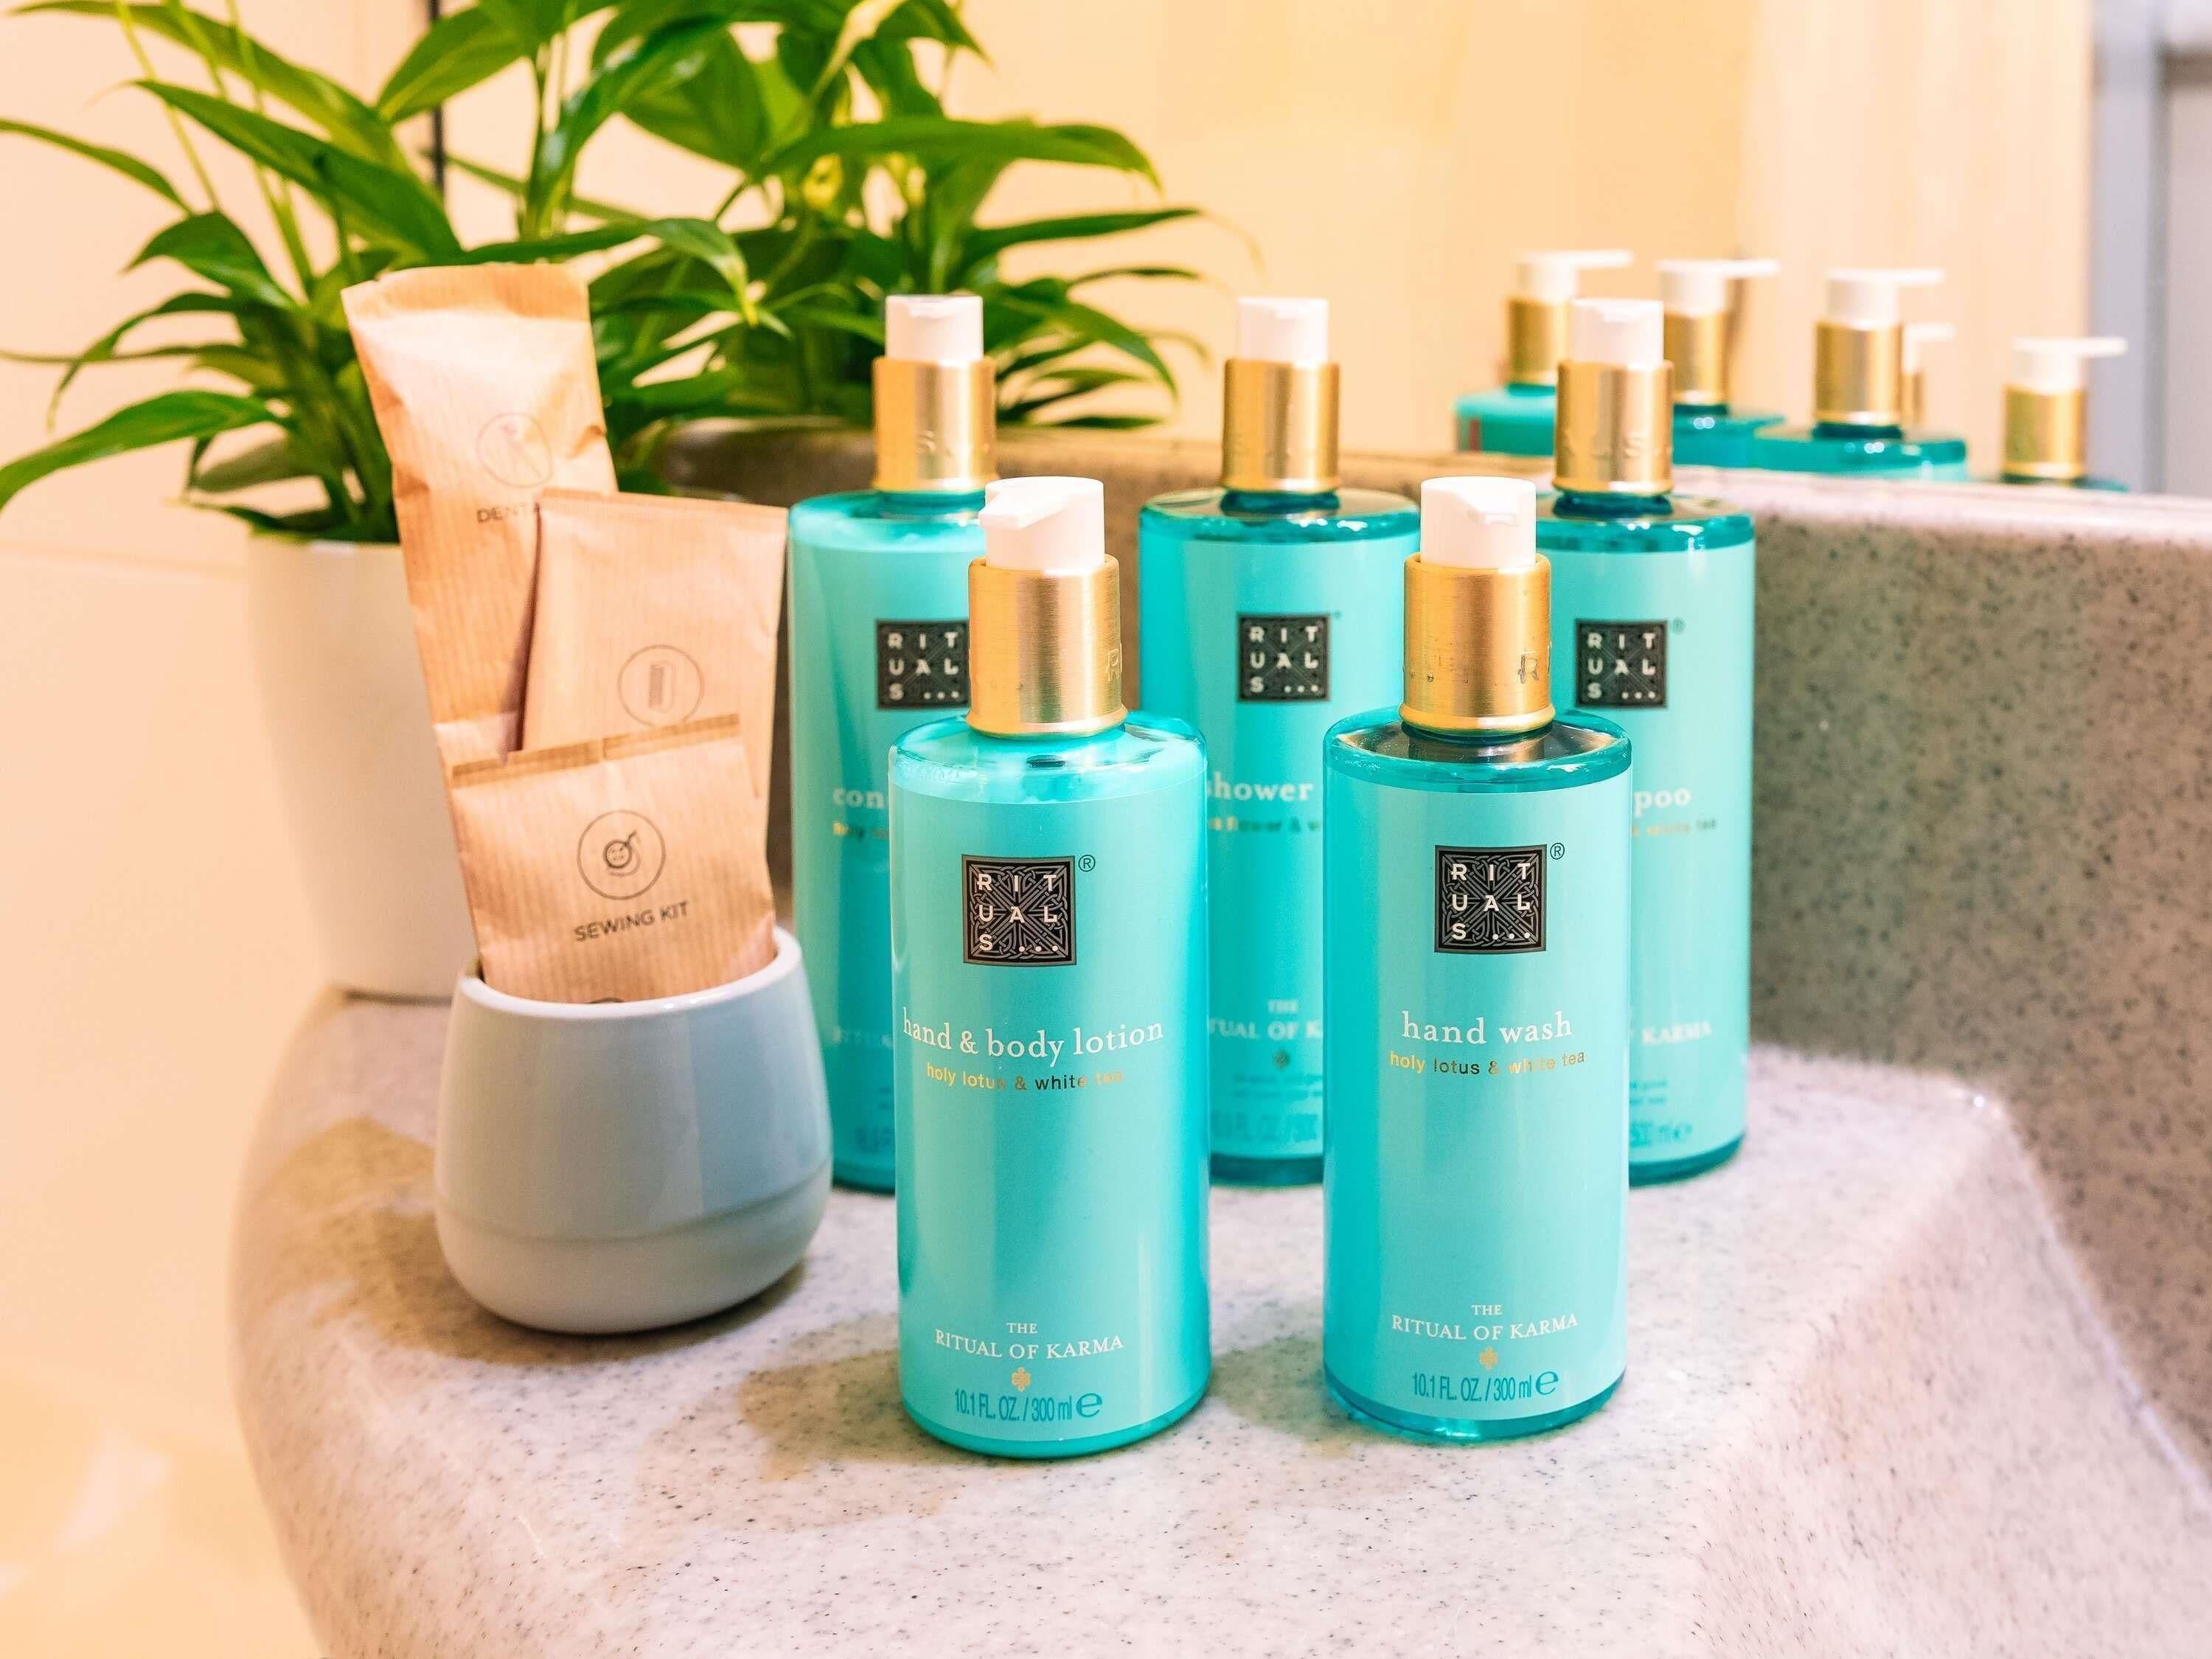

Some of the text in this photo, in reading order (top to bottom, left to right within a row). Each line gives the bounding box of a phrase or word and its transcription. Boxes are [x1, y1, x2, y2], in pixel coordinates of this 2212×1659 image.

[574, 900, 688, 942] SEWING KIT
[902, 1007, 952, 1051] hand
[960, 1031, 978, 1055] &
[986, 1029, 1064, 1067] body
[1074, 1021, 1164, 1056] lotion
[1402, 1010, 1573, 1045] hand wash
[925, 1062, 956, 1086] holy
[962, 1071, 1006, 1091] lotus
[1015, 1075, 1027, 1091] &
[1034, 1074, 1087, 1091] white
[1390, 1050, 1586, 1076] holy lotus & white tea
[1471, 1304, 1503, 1316] THE
[1006, 1322, 1038, 1334] THE
[1391, 1312, 1579, 1340] RITUAL OF KARMA
[934, 1328, 1124, 1359] RITUAL OF KARMA
[1412, 1371, 1436, 1399] 10.1
[955, 1388, 975, 1415] 10.1
